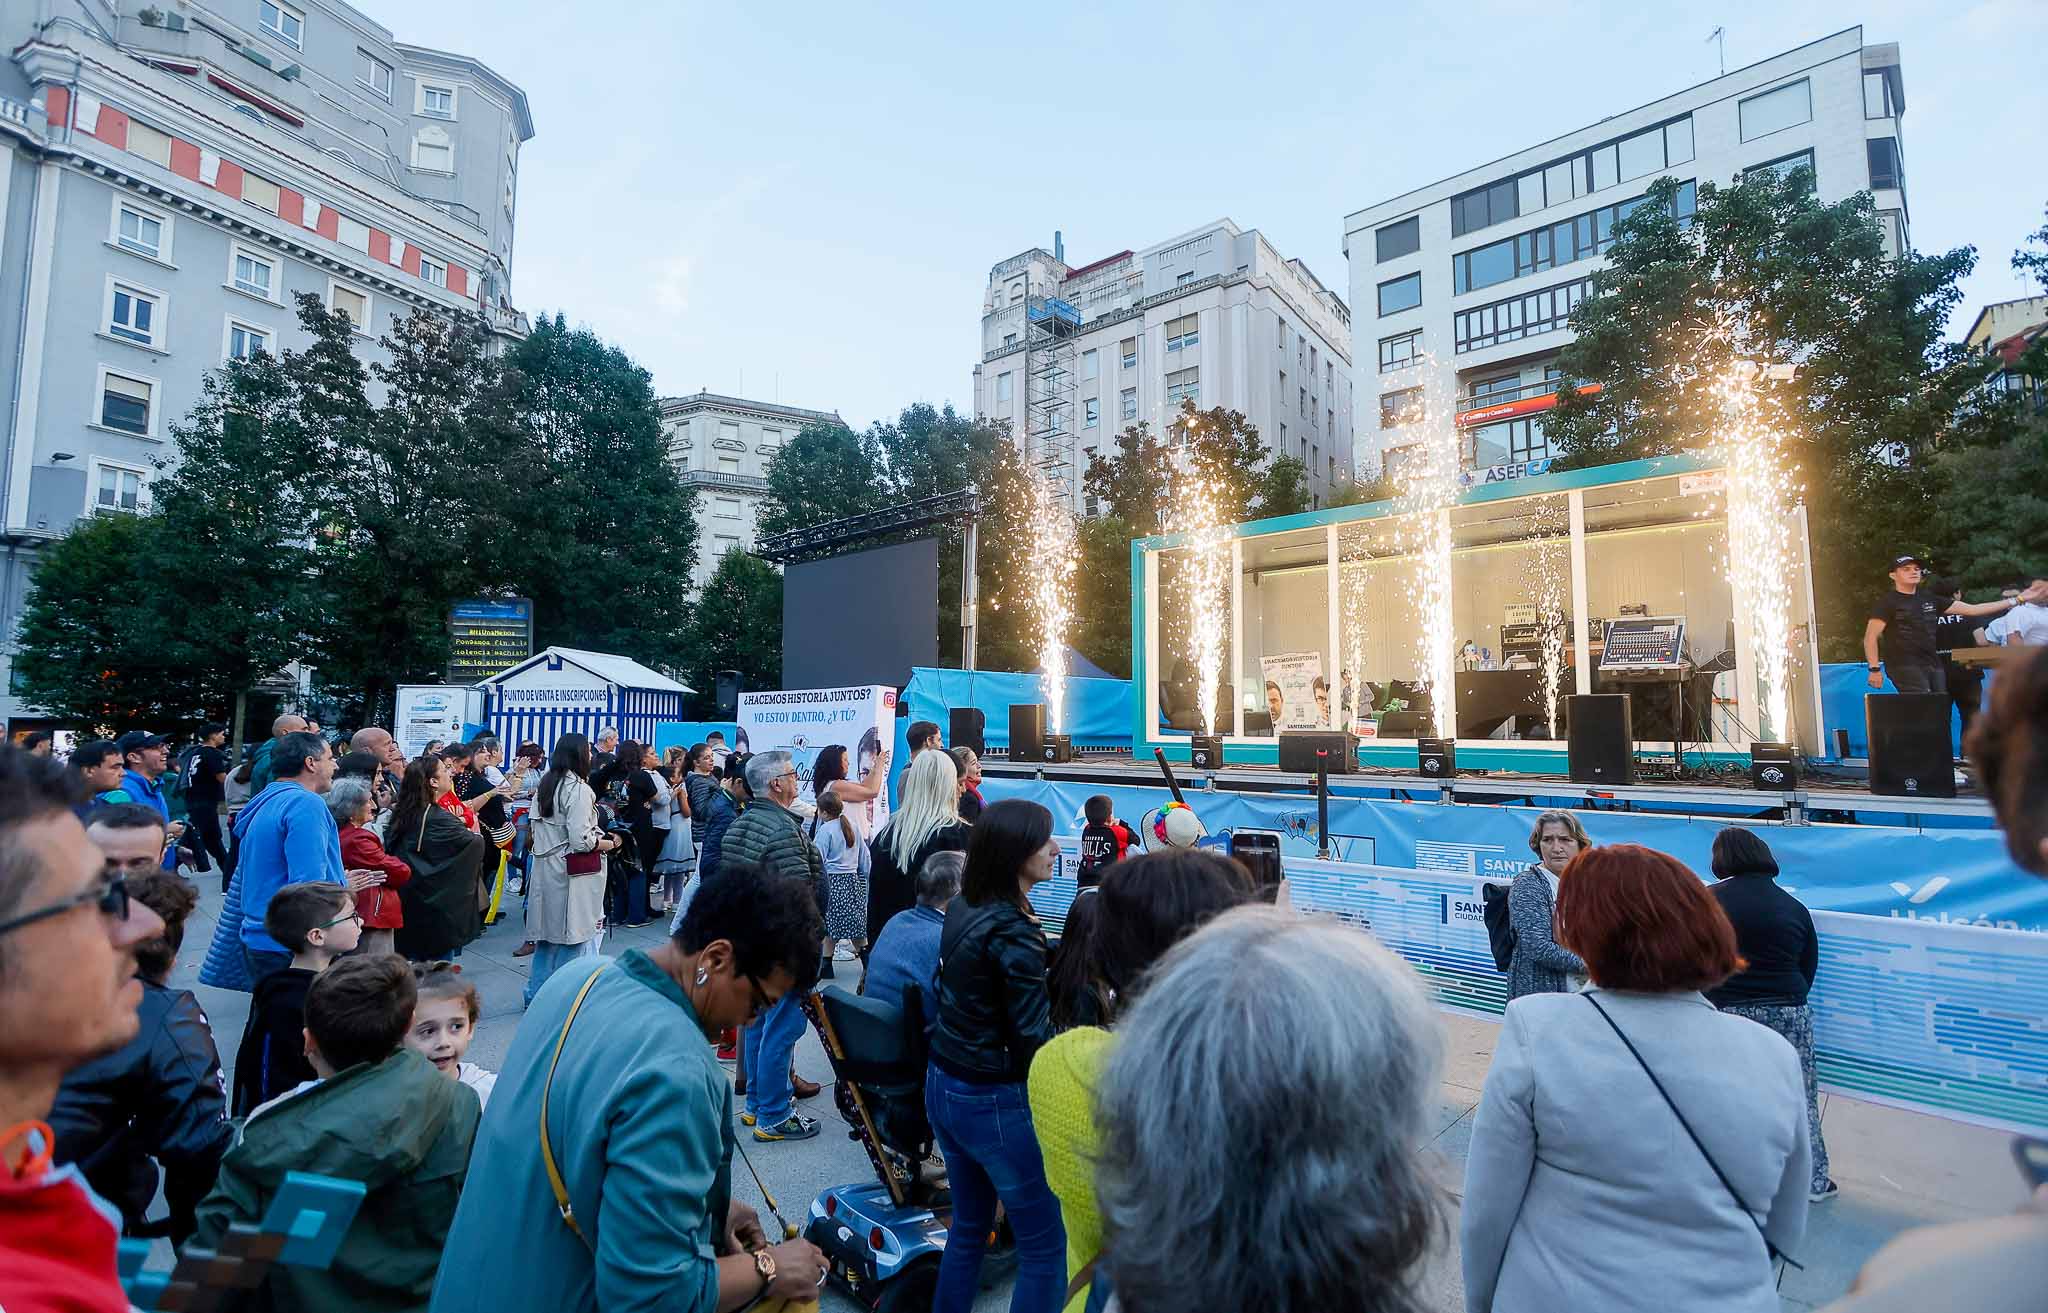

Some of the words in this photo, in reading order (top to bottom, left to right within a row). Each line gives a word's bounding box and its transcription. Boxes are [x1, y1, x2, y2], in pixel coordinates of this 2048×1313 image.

[504, 689, 524, 701] PUNTO
[526, 689, 534, 701] DE
[534, 689, 555, 701] VENTA
[555, 689, 560, 701] E
[560, 689, 607, 701] INSCRIPCIONES
[744, 692, 787, 706] ¿HACEMOS
[788, 691, 830, 704] HISTORIA
[830, 688, 871, 703] JUNTOS?
[754, 712, 764, 723] YO
[765, 711, 790, 723] ESTOY
[792, 711, 826, 724] DENTRO,
[828, 710, 838, 724] ¿Y
[840, 707, 856, 721] TÚ?
